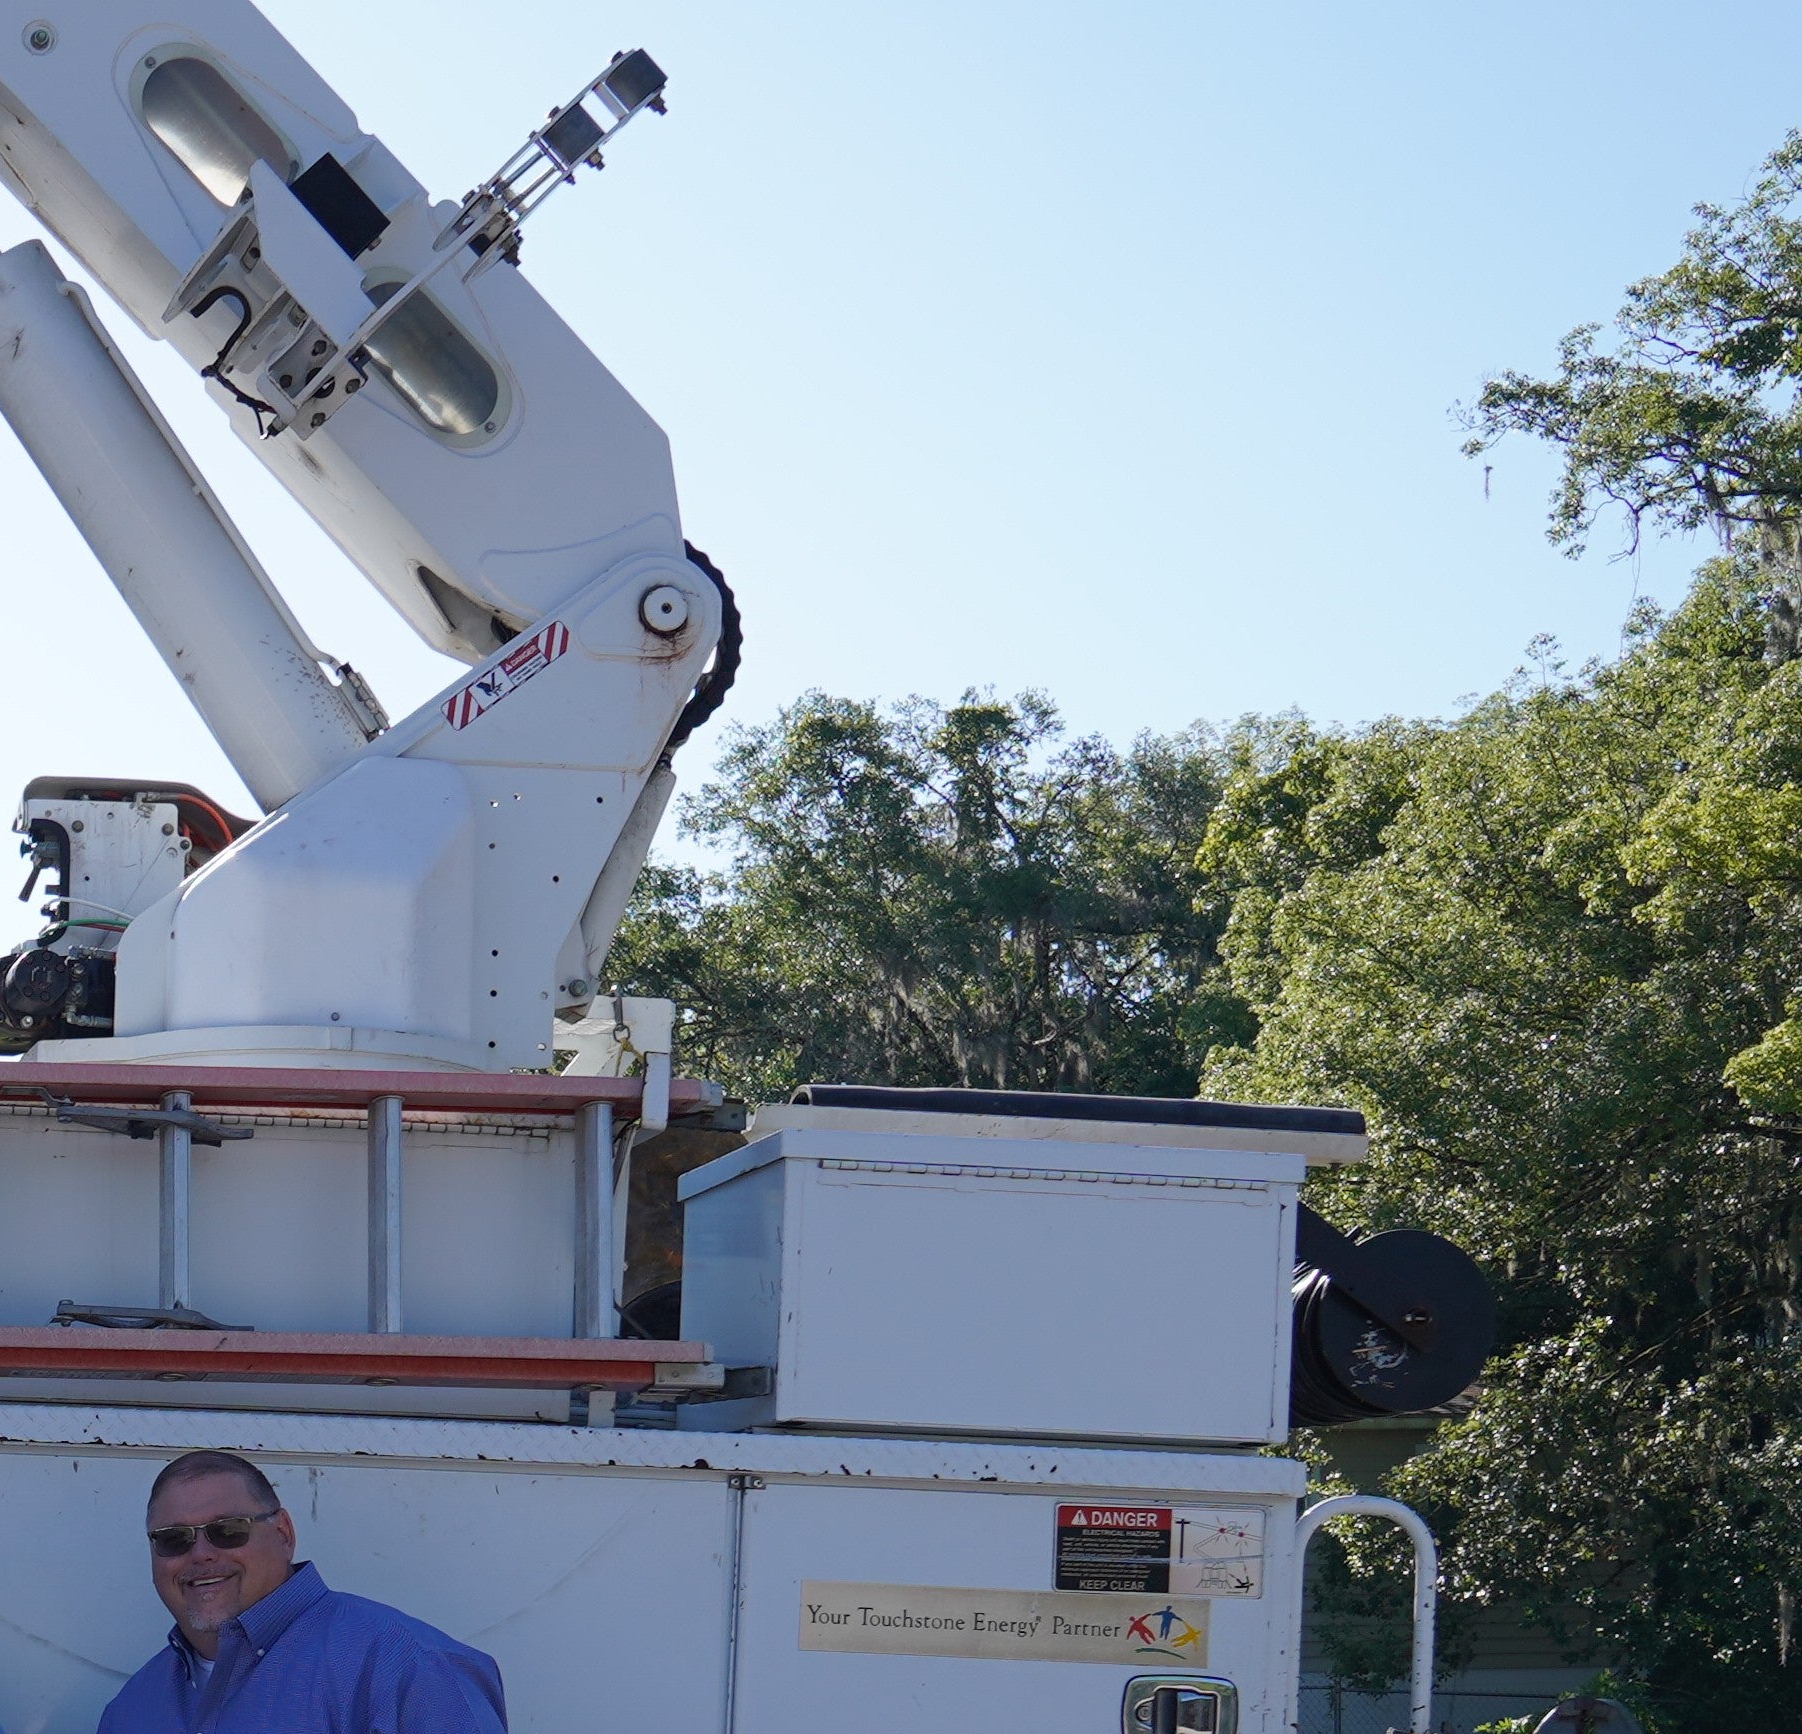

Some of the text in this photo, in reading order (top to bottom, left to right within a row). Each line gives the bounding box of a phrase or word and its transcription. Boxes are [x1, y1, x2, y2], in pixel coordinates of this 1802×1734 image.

[1091, 1511, 1157, 1527] DANGER
[1082, 1528, 1160, 1538] ELECTRICAL HAZARDS
[1079, 1579, 1145, 1591] KEEP CLEAR
[807, 1604, 850, 1626] Your
[858, 1605, 965, 1631] Touchstone
[1051, 1616, 1121, 1638] Partner
